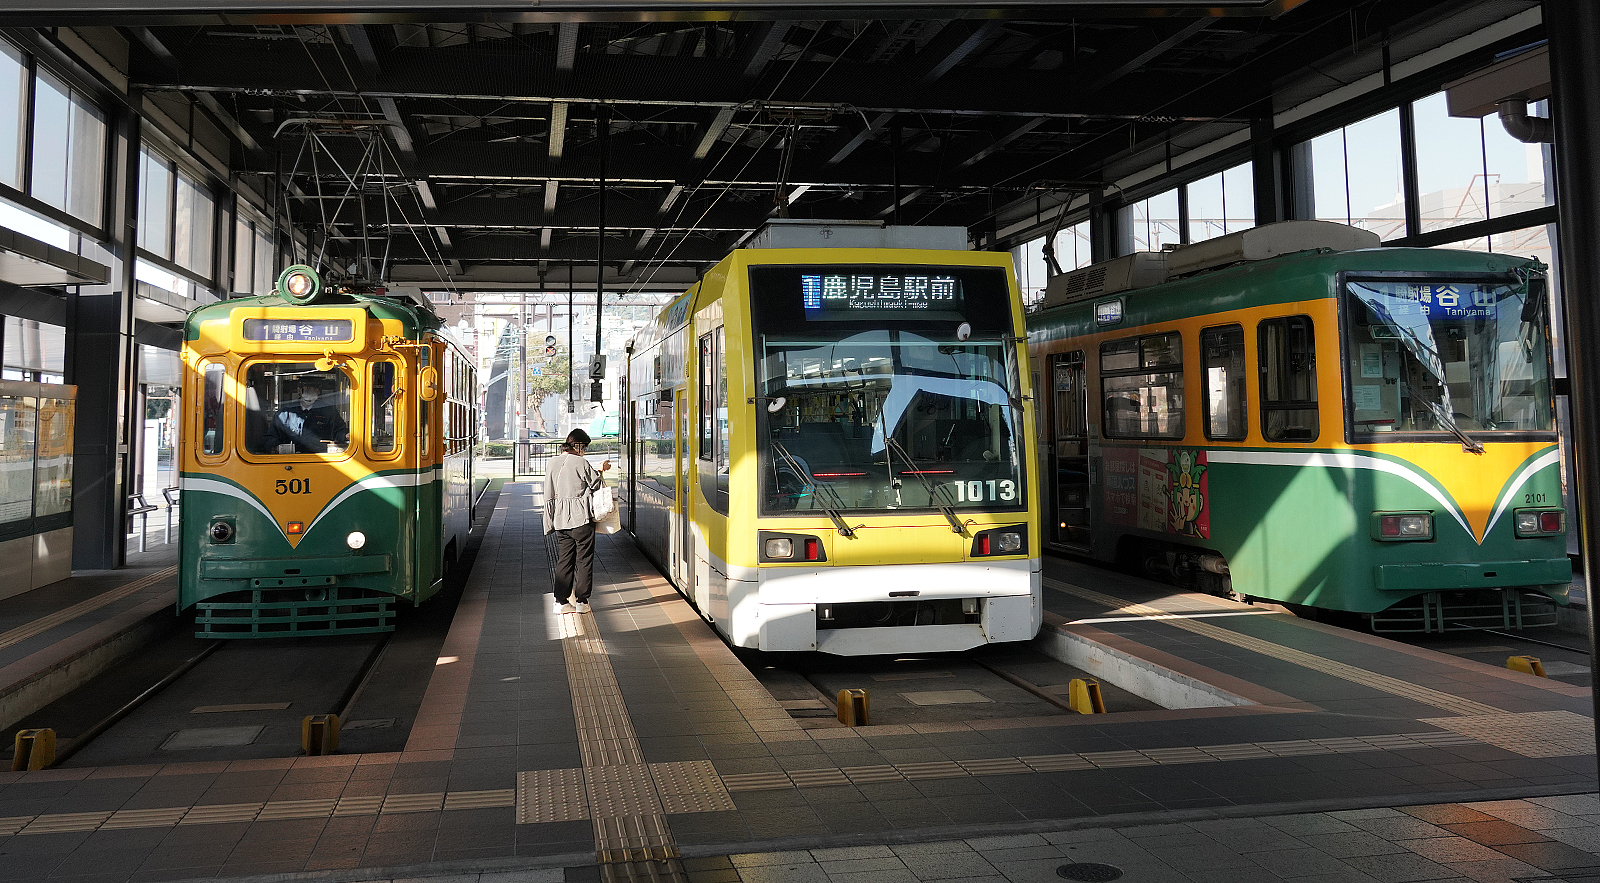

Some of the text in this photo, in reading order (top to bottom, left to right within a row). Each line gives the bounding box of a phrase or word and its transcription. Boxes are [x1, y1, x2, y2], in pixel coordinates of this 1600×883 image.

[803, 275, 955, 306] 1 鹿児島駅前
[1445, 307, 1491, 317] Taniyama
[263, 325, 269, 340] 1
[593, 361, 602, 375] 2
[275, 478, 312, 495] 501
[954, 480, 1016, 502] 1013
[1525, 493, 1546, 504] 2101
